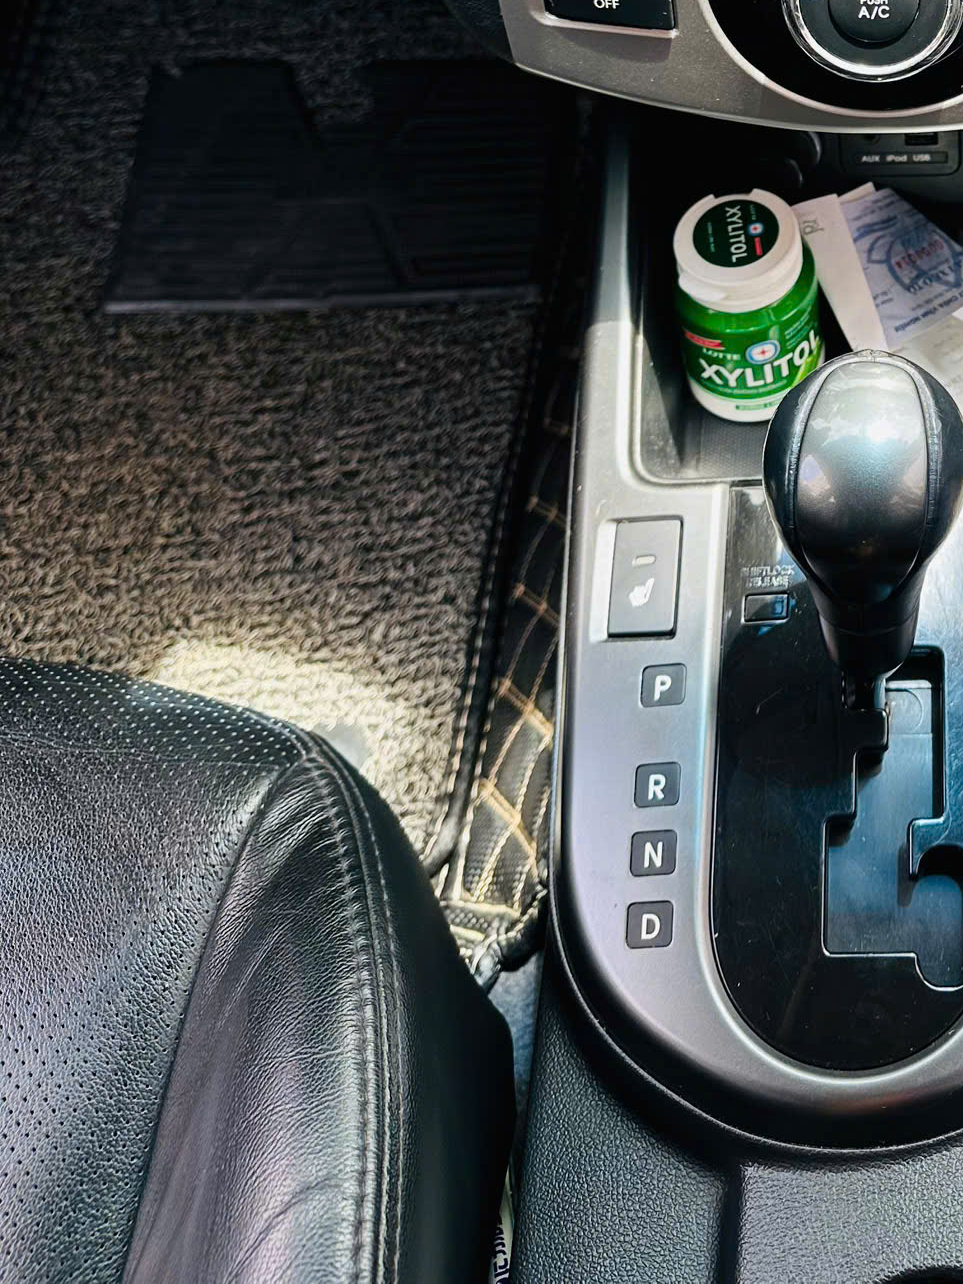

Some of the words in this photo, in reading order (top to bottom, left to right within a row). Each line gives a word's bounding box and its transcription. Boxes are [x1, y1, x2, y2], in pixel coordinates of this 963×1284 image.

[857, 5, 890, 20] A/C
[861, 154, 881, 163] AUX
[886, 153, 908, 163] iPod
[912, 153, 932, 163] USB
[724, 205, 748, 264] XYLITOL
[698, 328, 820, 388] XYLITOL
[654, 674, 672, 701] P
[648, 772, 666, 801] R
[643, 841, 663, 869] N
[640, 912, 661, 940] D
